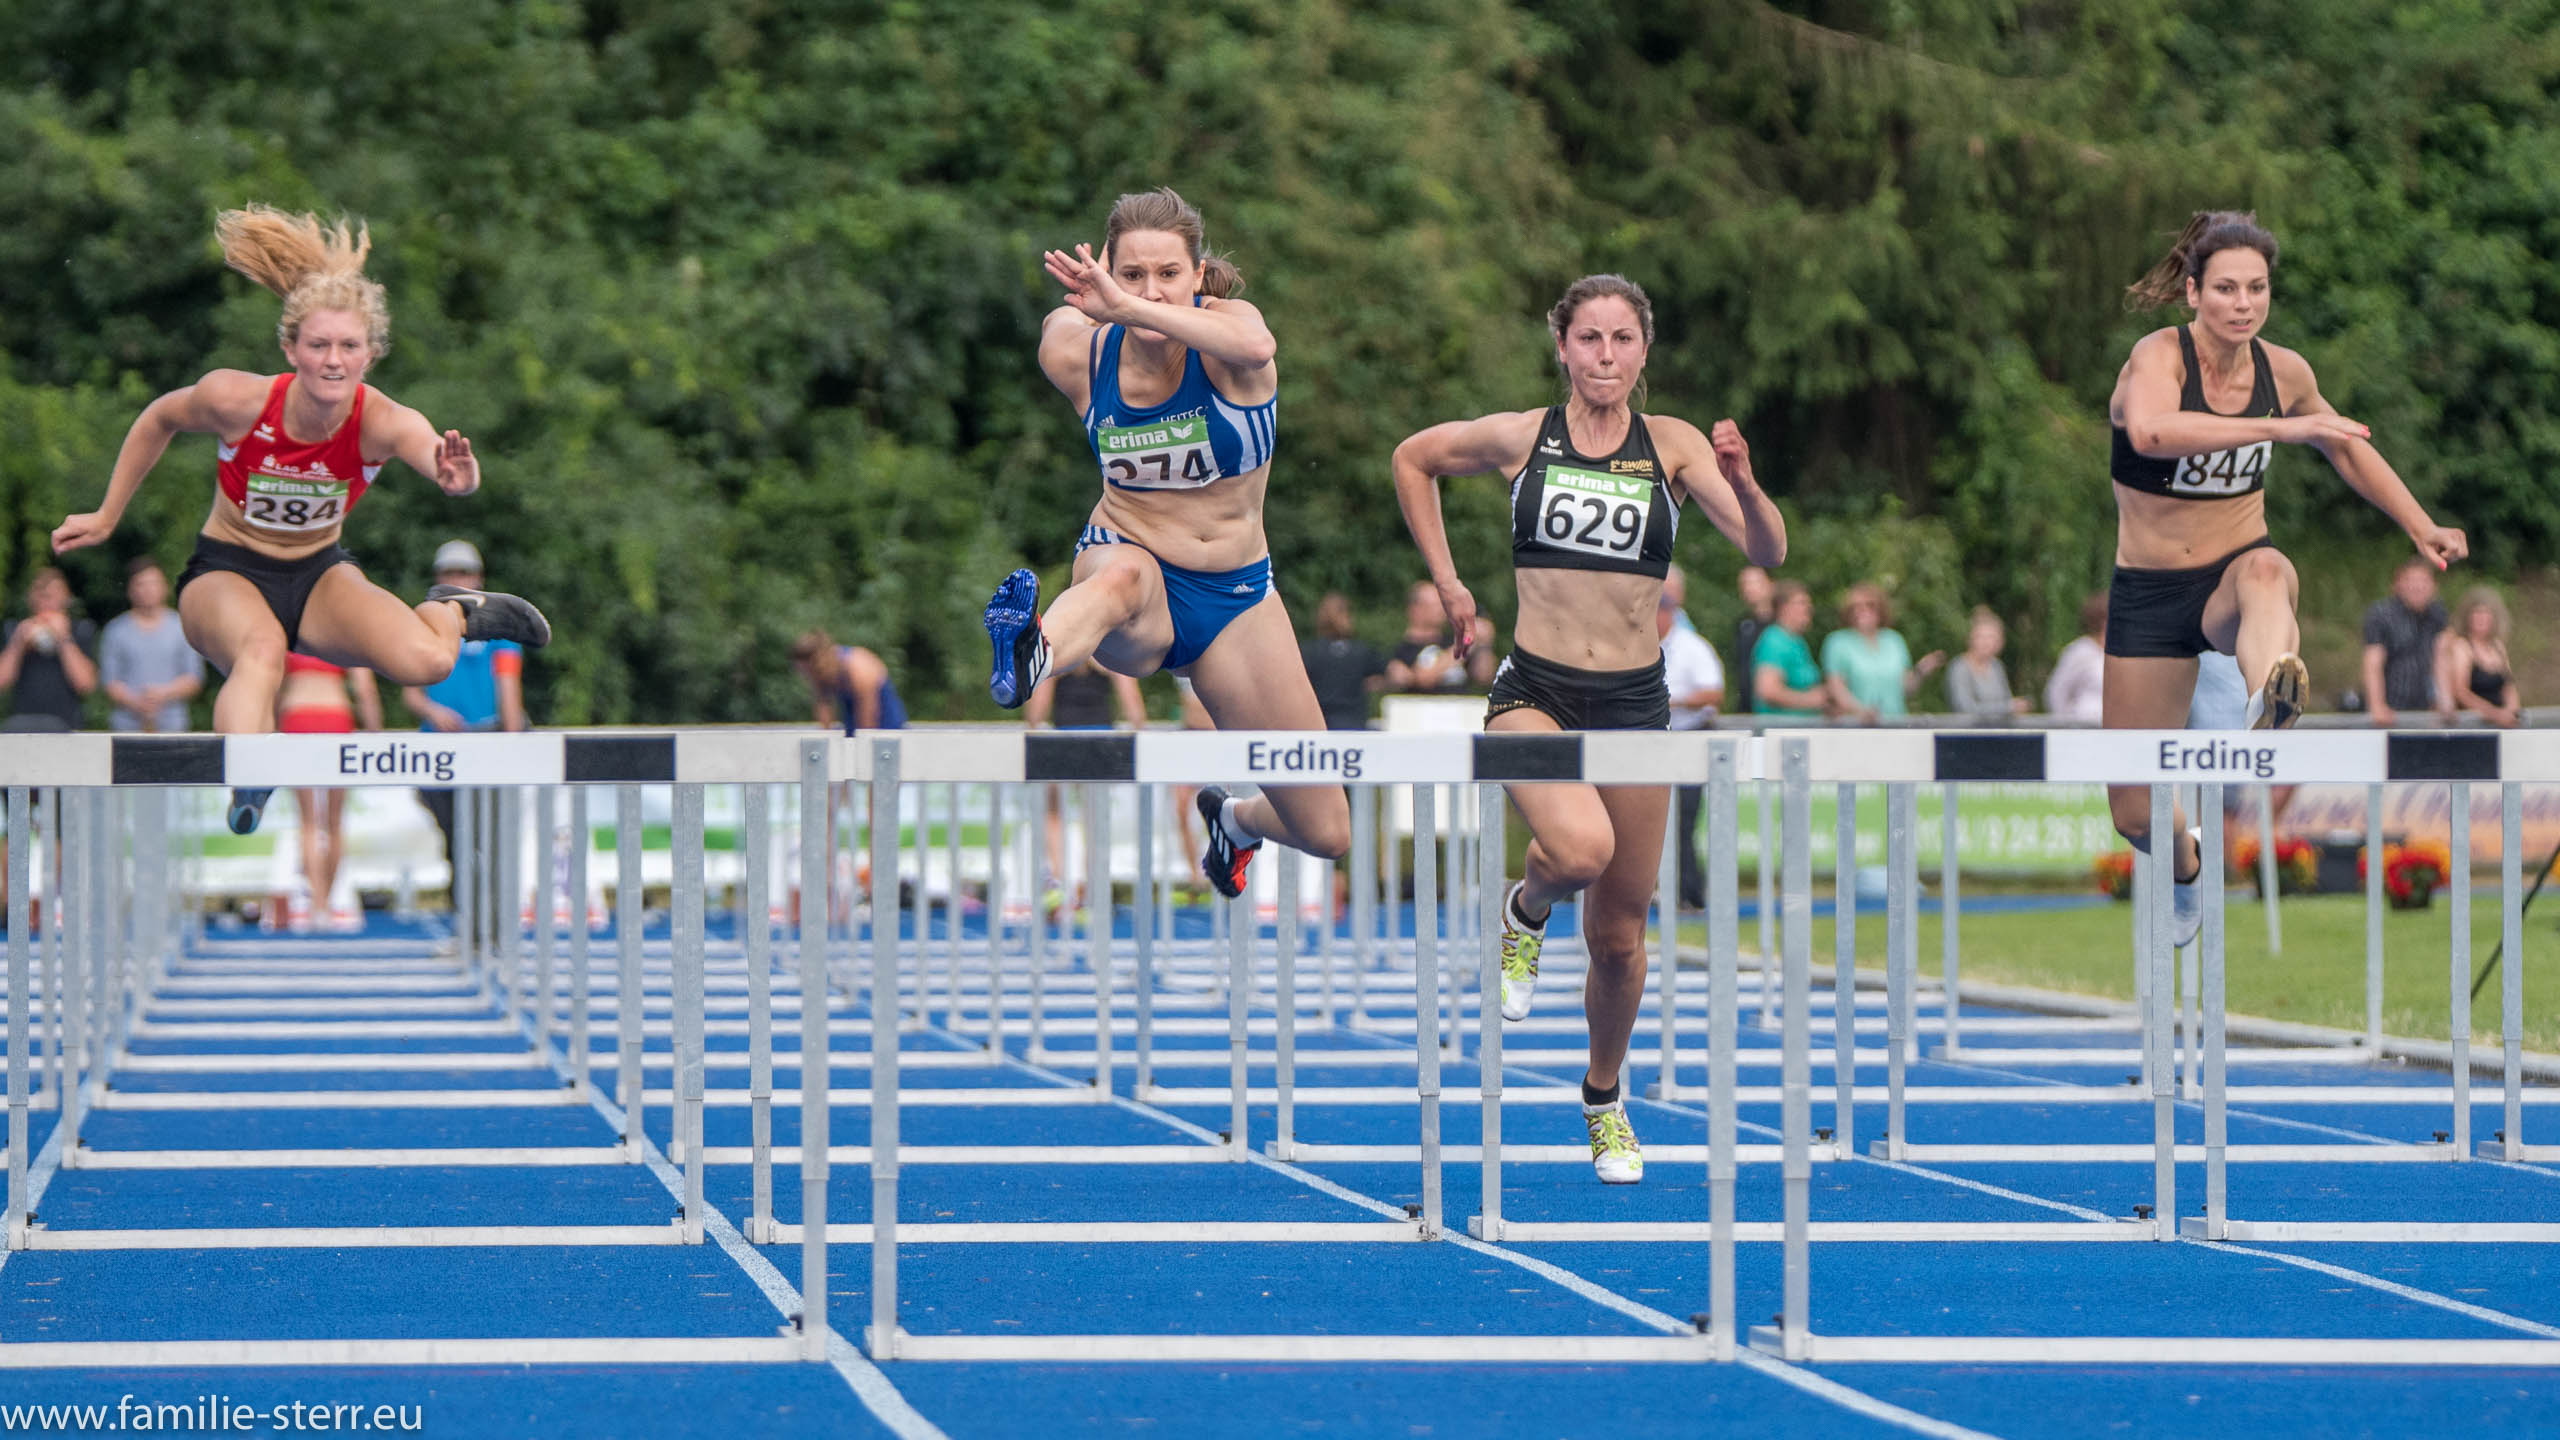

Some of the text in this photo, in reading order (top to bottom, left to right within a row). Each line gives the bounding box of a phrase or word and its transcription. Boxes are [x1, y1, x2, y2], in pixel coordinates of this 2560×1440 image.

[1109, 430, 1168, 448] erima
[1557, 473, 1616, 493] erima
[2181, 446, 2265, 487] 844
[257, 480, 314, 493] erima
[251, 497, 339, 525] 284
[1545, 492, 1641, 551] 629
[340, 743, 456, 781] Erding
[1248, 740, 1363, 778] Erding
[2160, 739, 2276, 778] Erding
